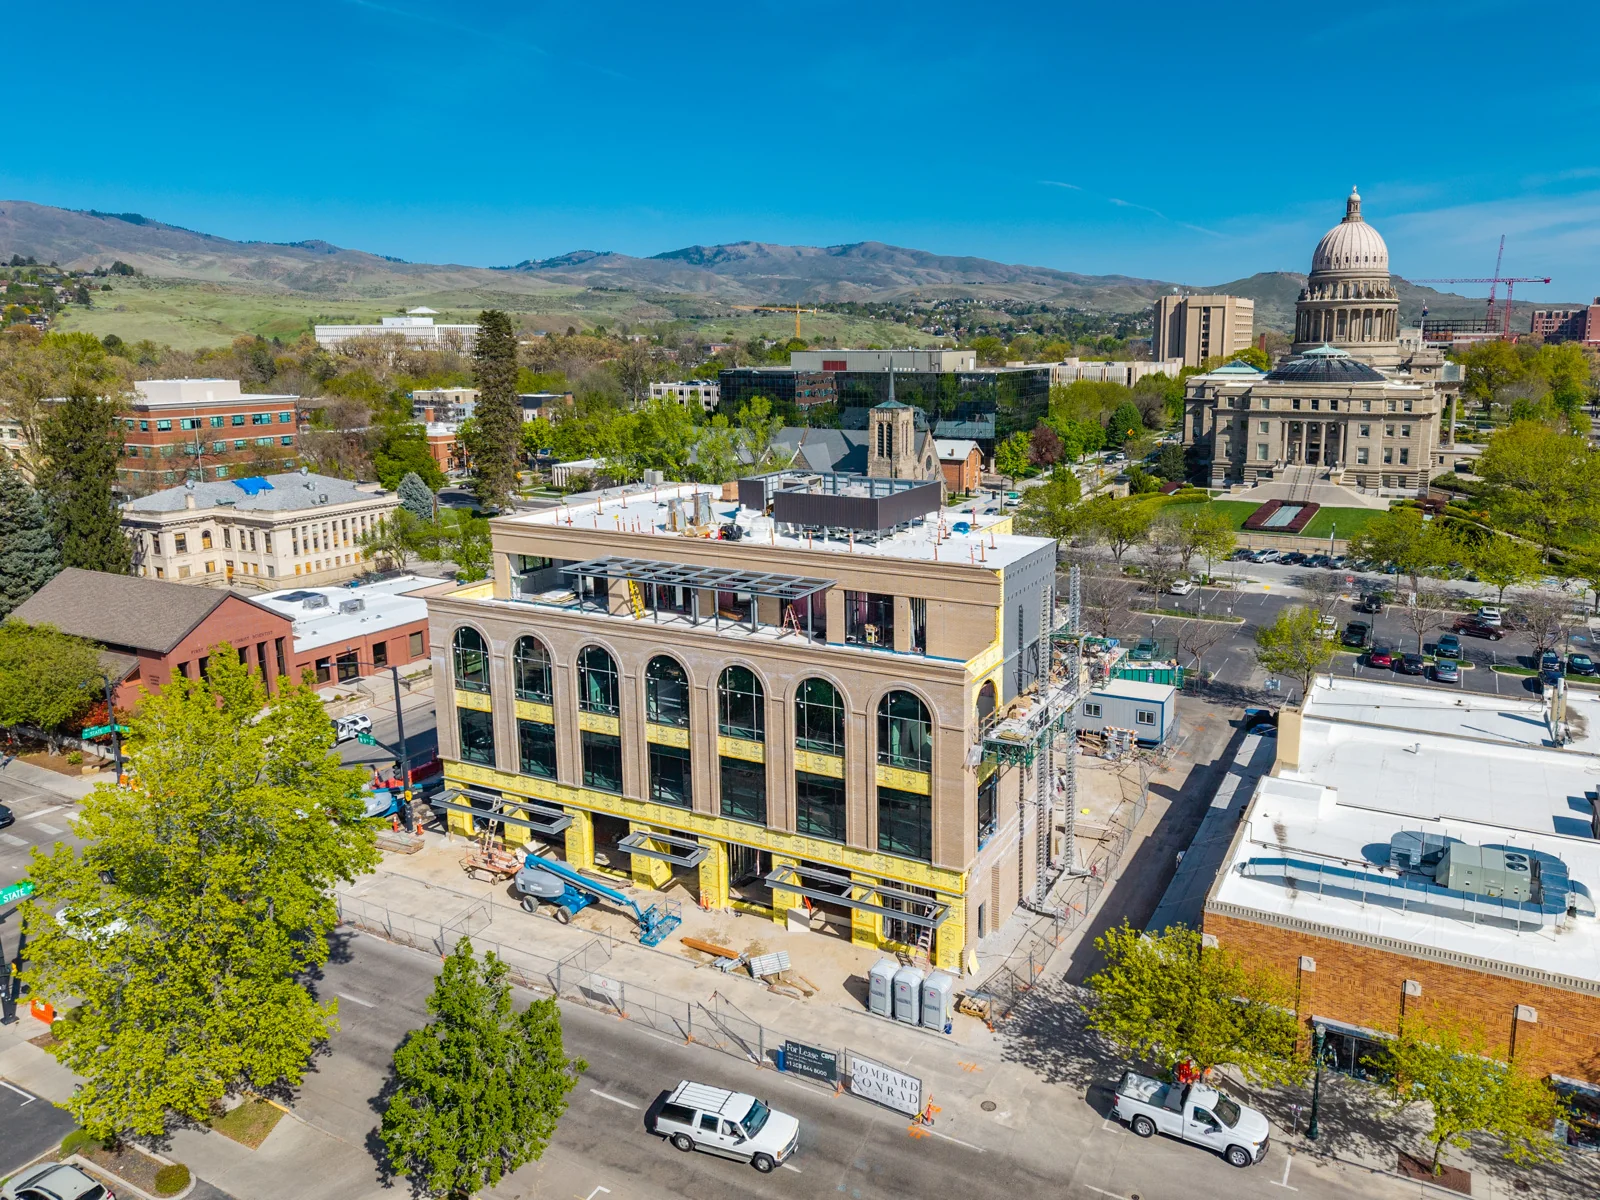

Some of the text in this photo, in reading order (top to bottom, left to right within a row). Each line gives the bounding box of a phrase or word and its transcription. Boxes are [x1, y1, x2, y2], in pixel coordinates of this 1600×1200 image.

[90, 729, 103, 737] STATE
[2, 888, 25, 904] STATE
[786, 1043, 799, 1054] For
[799, 1046, 819, 1060] Lease
[820, 1052, 836, 1061] CBRE
[852, 1061, 919, 1092] LOMBARD
[852, 1073, 918, 1104] CONRAD
